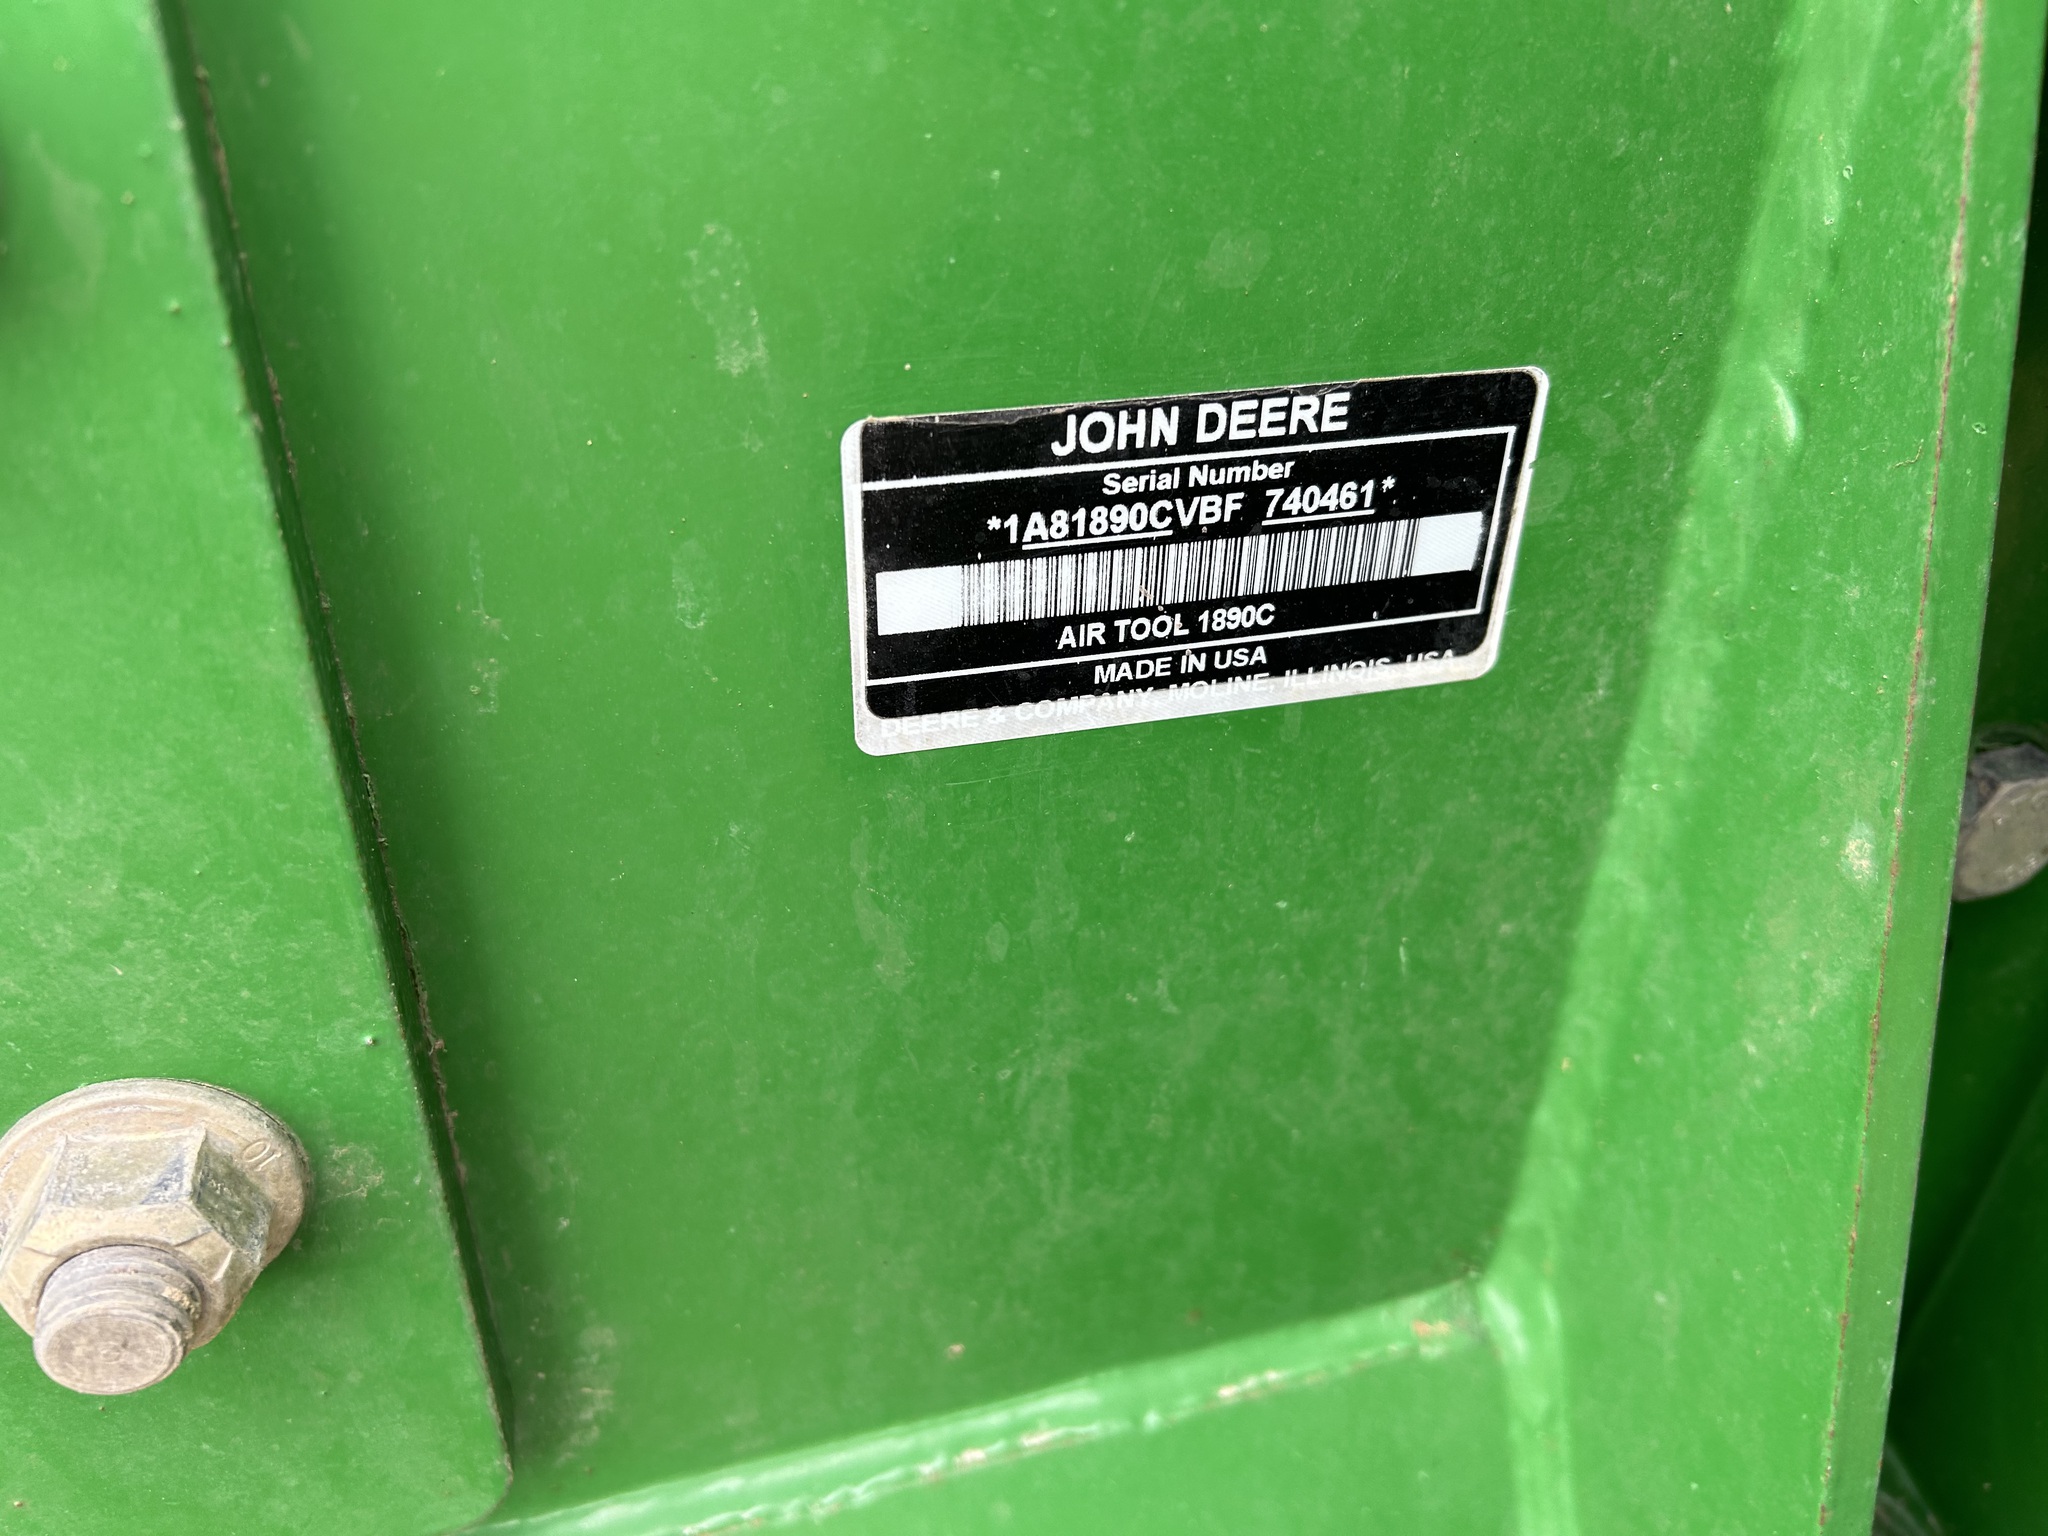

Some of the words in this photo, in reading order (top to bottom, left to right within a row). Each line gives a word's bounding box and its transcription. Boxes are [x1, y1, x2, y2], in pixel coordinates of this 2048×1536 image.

[1051, 406, 1180, 456] JOHN
[1196, 392, 1351, 444] DEERE
[1102, 467, 1180, 495] Serial
[1189, 460, 1295, 487] Number
[1057, 622, 1106, 650] AIR
[1114, 613, 1189, 643] TOOL
[1198, 603, 1276, 633] 1890C
[1094, 657, 1173, 684] MADE
[1180, 652, 1206, 674] IN
[1214, 646, 1267, 670] USA
[880, 707, 979, 737] DEERE
[986, 705, 1006, 725] &
